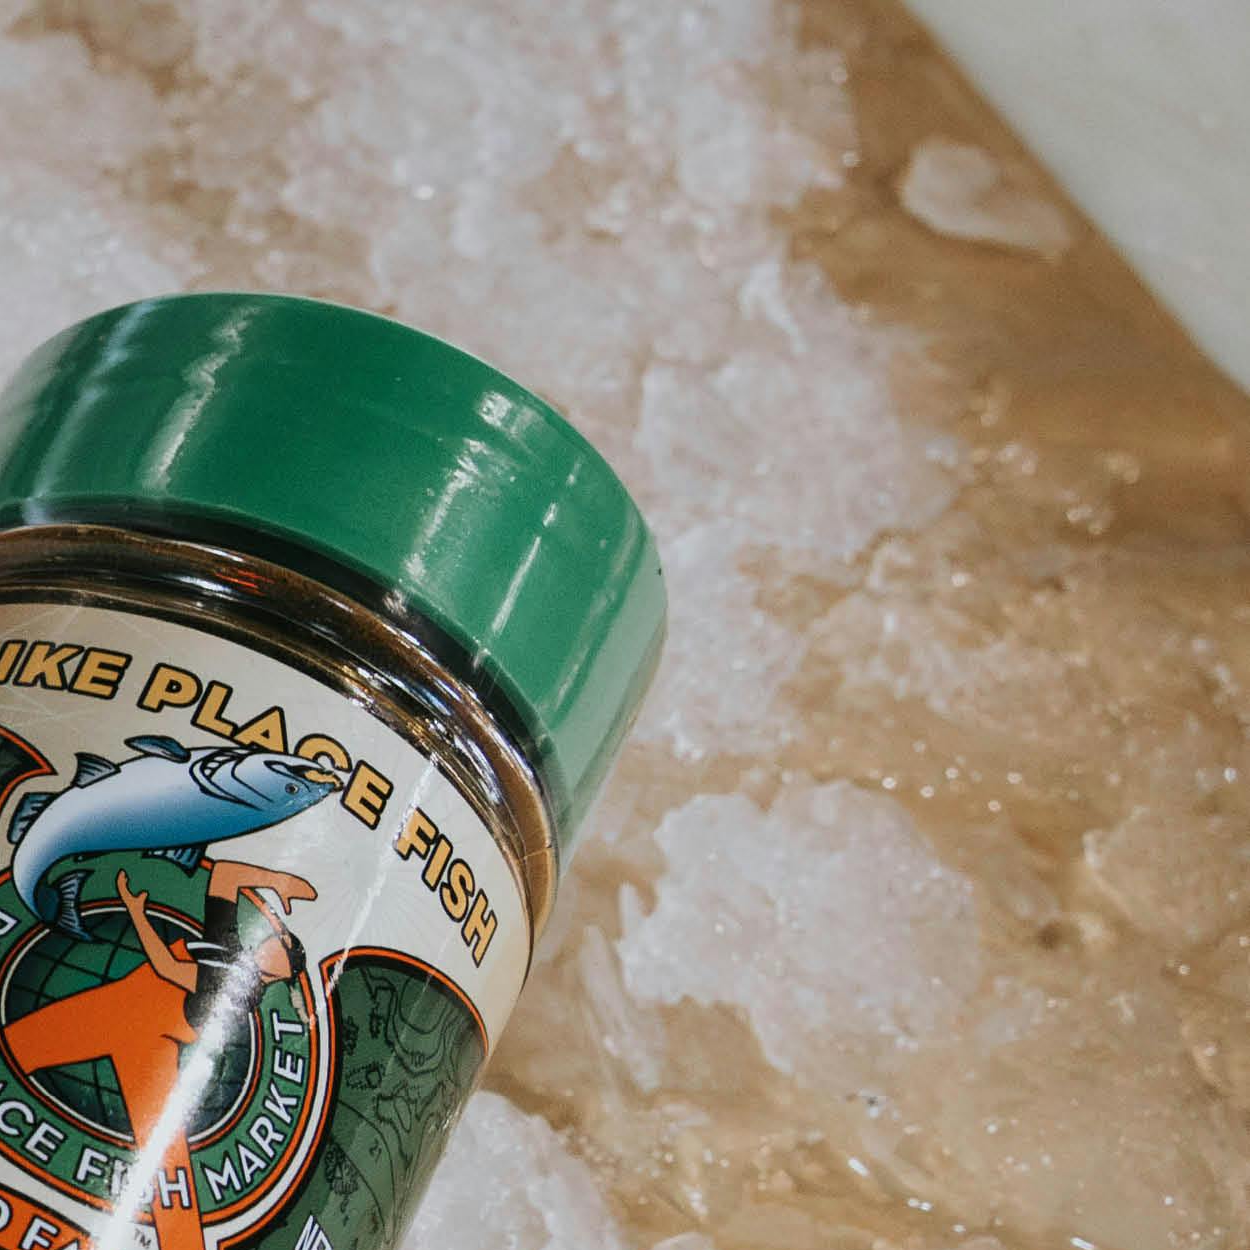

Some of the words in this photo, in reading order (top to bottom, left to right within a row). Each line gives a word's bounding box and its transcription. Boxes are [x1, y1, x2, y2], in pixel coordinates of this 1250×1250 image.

[137, 662, 394, 831] PLACE
[392, 805, 498, 969] FISH
[74, 1147, 192, 1210] FIH
[204, 1010, 305, 1201] MARKET
